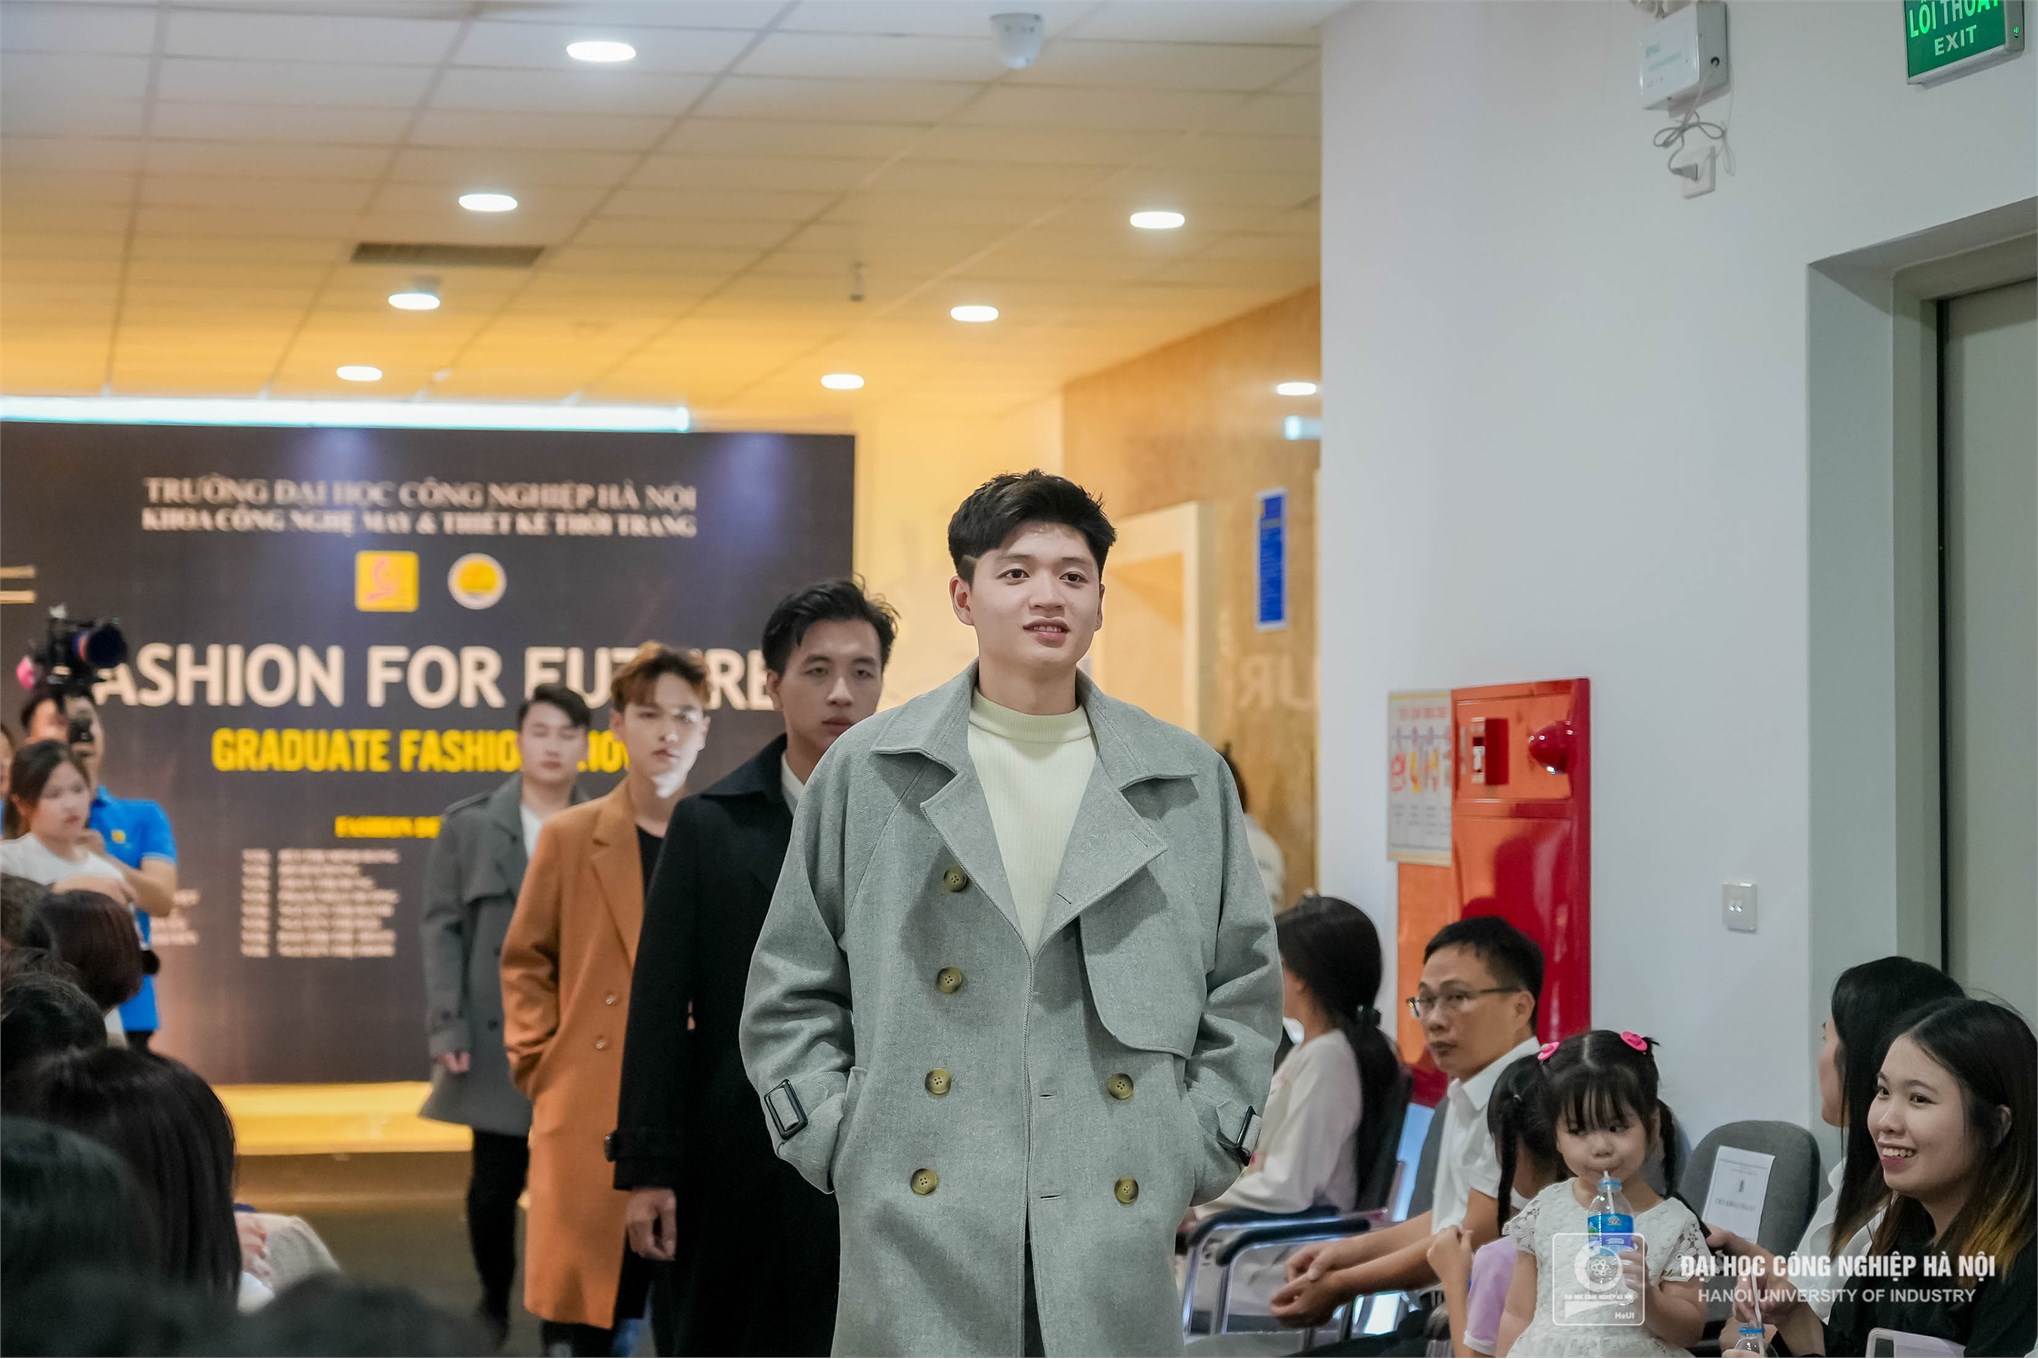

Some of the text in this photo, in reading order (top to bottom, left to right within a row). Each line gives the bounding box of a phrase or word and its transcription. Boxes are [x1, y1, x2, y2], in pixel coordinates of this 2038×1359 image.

[1934, 24, 1977, 56] EXIT
[90, 642, 784, 711] ASHION FOR FURE
[211, 728, 392, 773] GRADUATE
[400, 729, 522, 773] FASHIO
